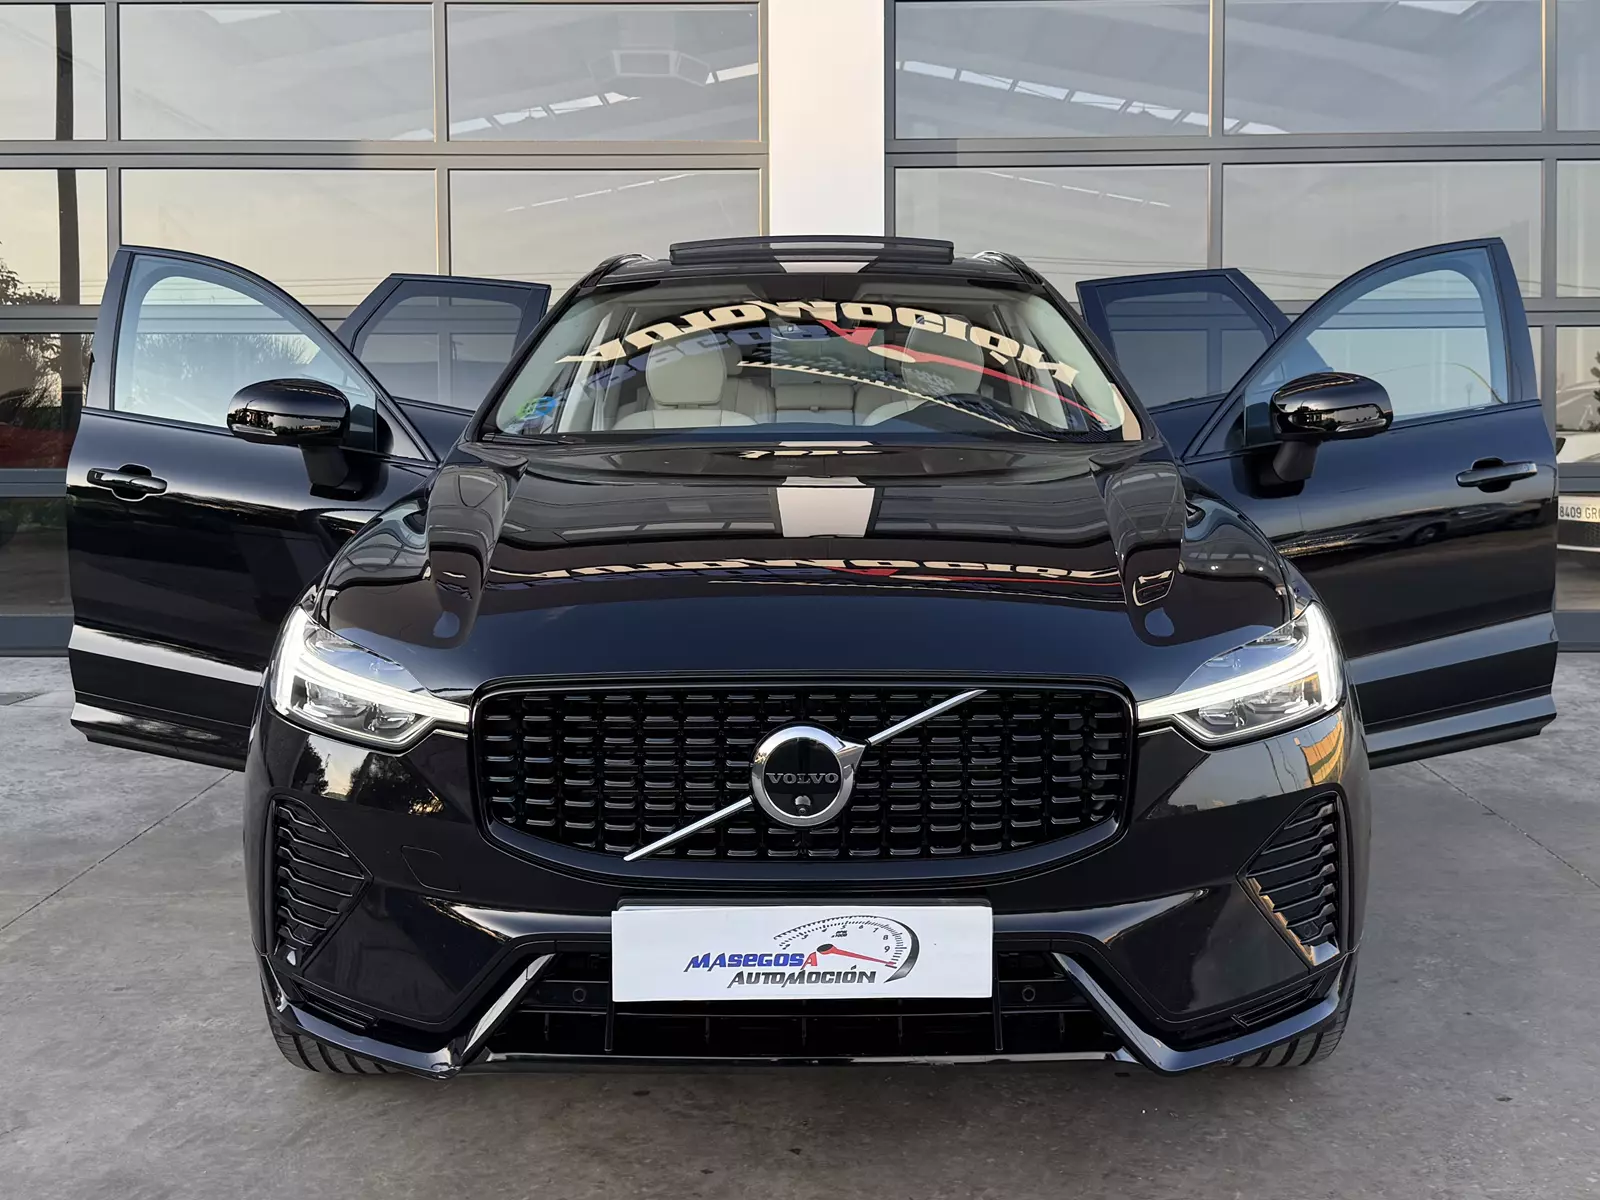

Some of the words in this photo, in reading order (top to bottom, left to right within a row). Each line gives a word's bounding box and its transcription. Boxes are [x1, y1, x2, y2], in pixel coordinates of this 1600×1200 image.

[1559, 505, 1582, 519] 8409
[1585, 506, 1600, 520] GR
[765, 772, 840, 785] VOLVO
[884, 945, 891, 954] 9
[727, 965, 877, 989] AUTOMOCIÓN
